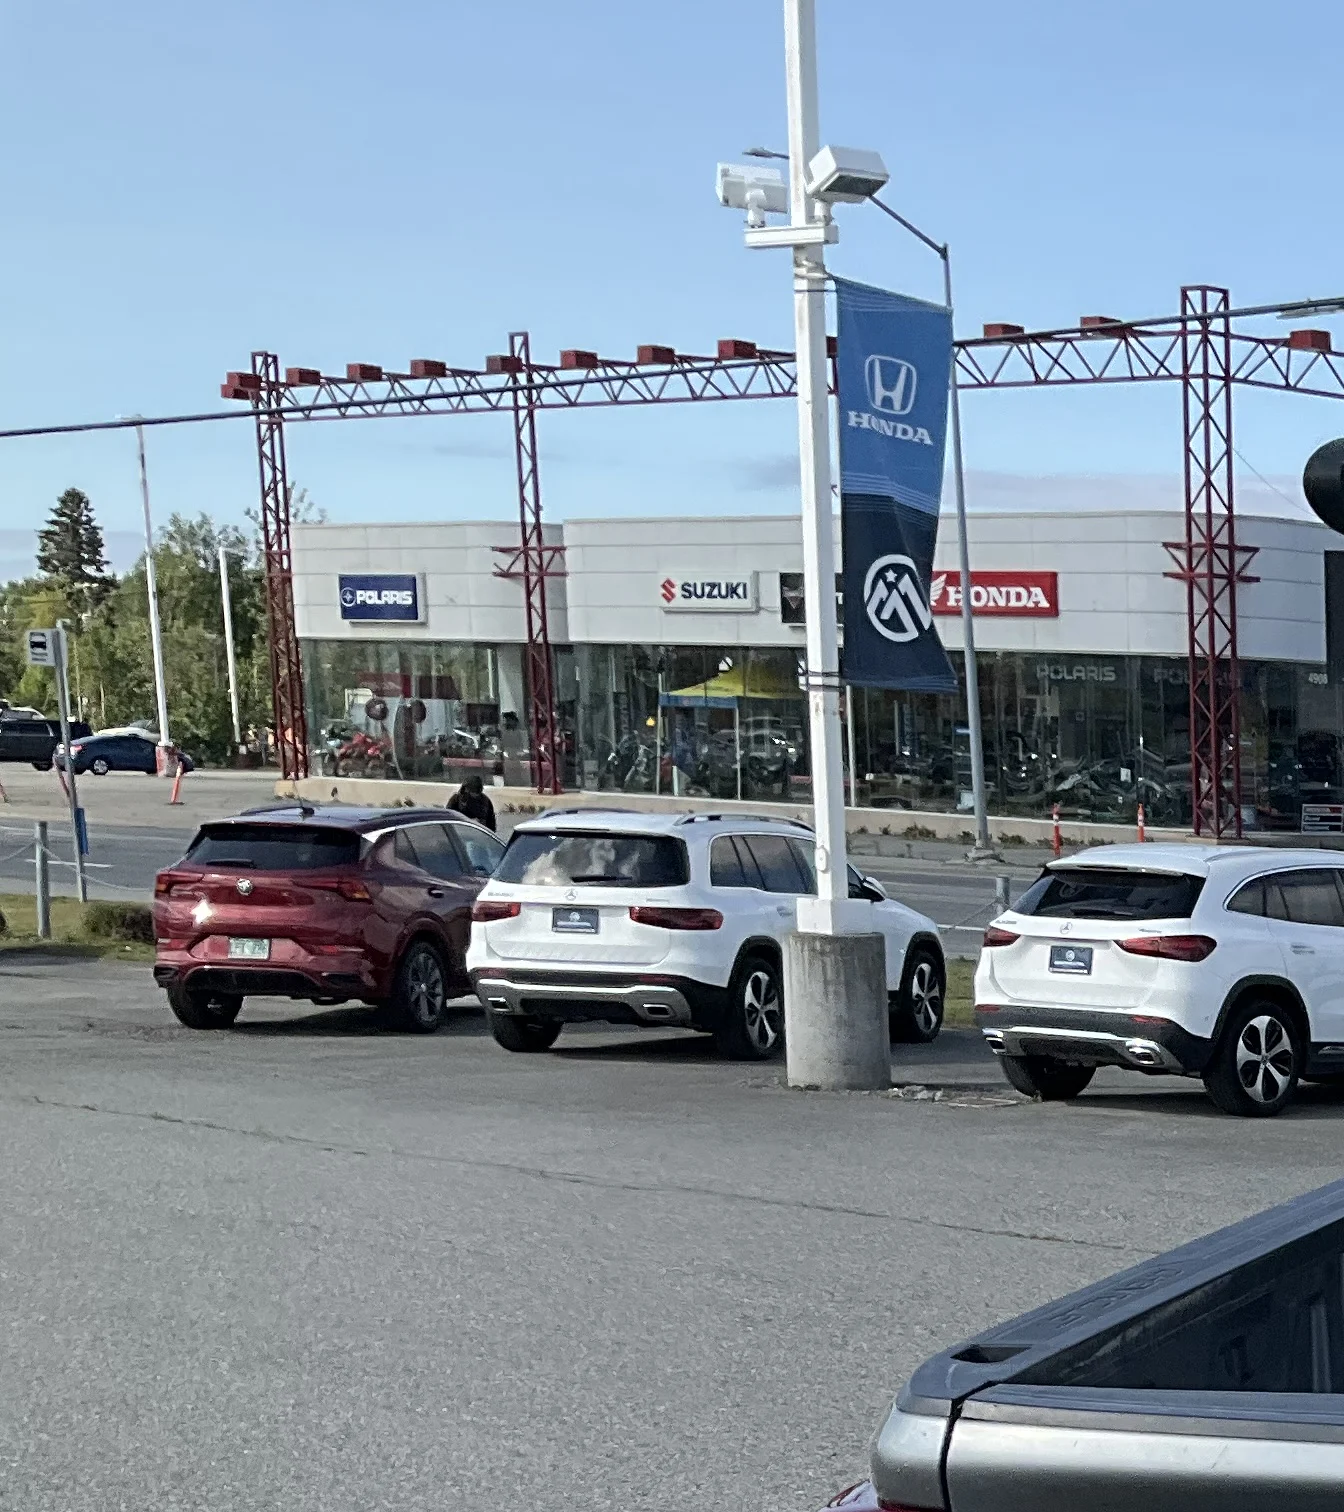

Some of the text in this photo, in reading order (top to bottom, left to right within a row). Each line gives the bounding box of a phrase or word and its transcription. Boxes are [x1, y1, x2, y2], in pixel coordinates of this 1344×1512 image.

[848, 410, 933, 446] HONDA
[356, 589, 413, 606] POLARIS
[680, 581, 748, 600] SUZUKI
[946, 585, 1050, 608] HONDA
[1036, 664, 1116, 682] POLARIS
